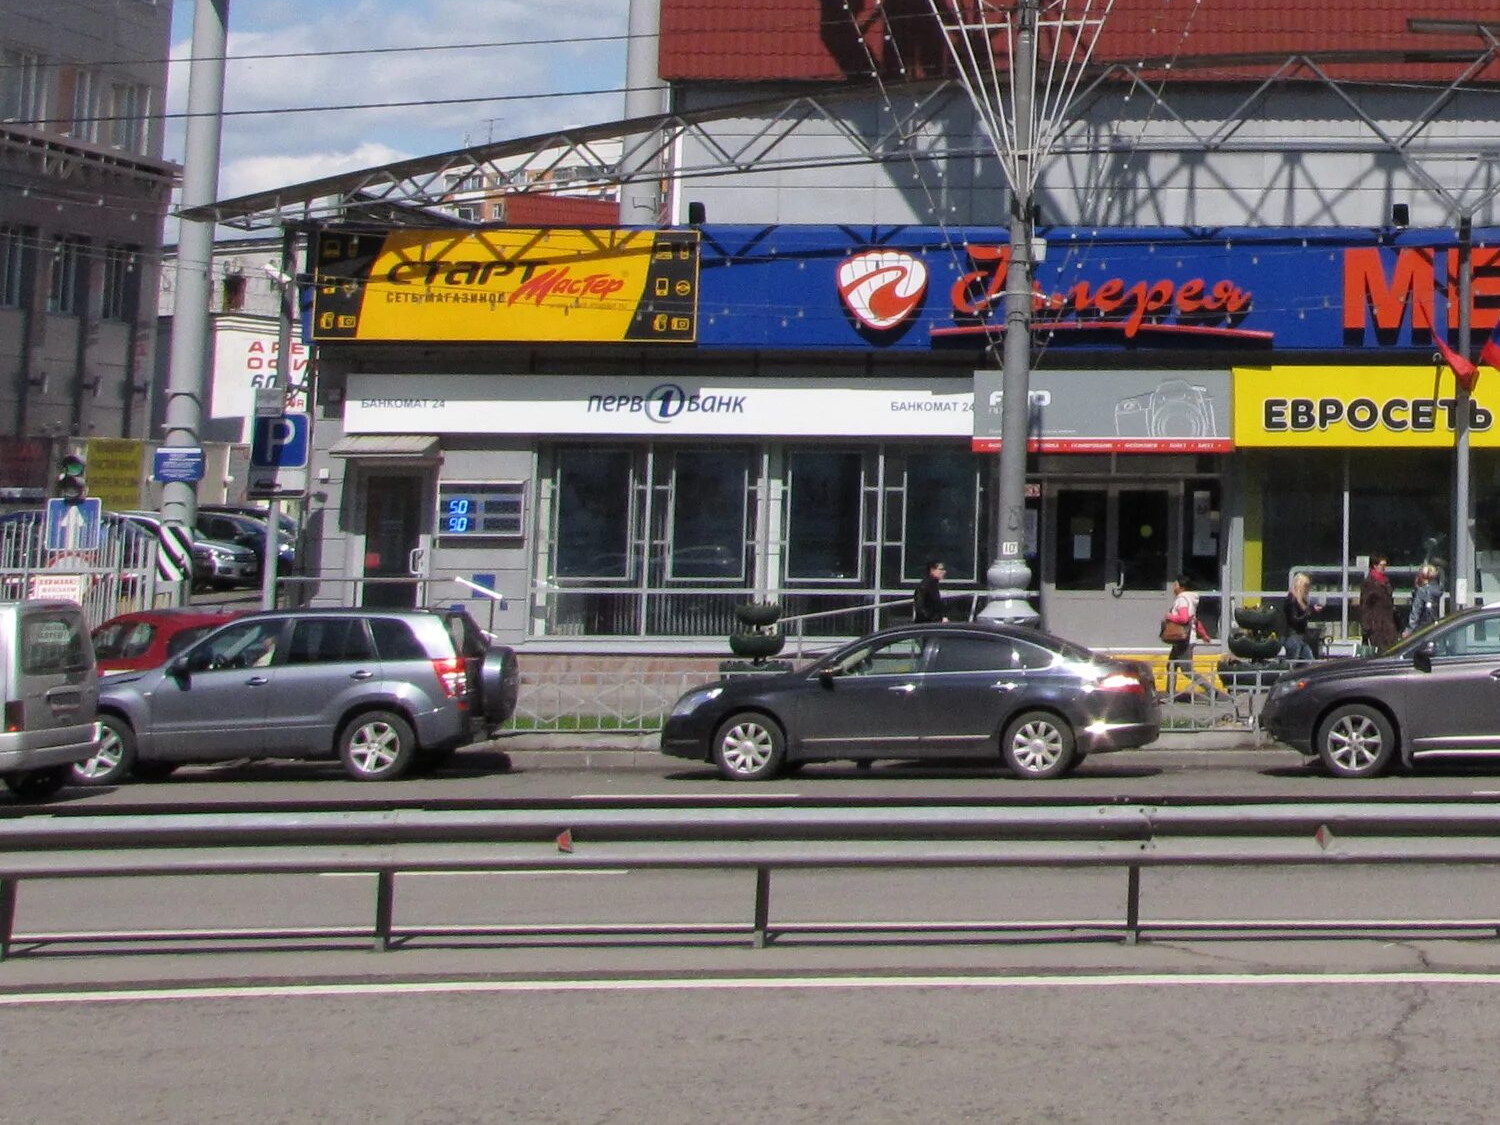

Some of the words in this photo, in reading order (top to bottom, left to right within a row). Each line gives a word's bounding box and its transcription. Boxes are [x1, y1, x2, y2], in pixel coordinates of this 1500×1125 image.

[508, 266, 624, 307] Мастер
[951, 244, 1252, 338] Глерея
[361, 399, 427, 408] БАНКОМАТ
[432, 399, 445, 408] 24
[890, 401, 959, 412] БАНКОМАТ
[1264, 398, 1495, 432] ЕВРОСЕТЬ
